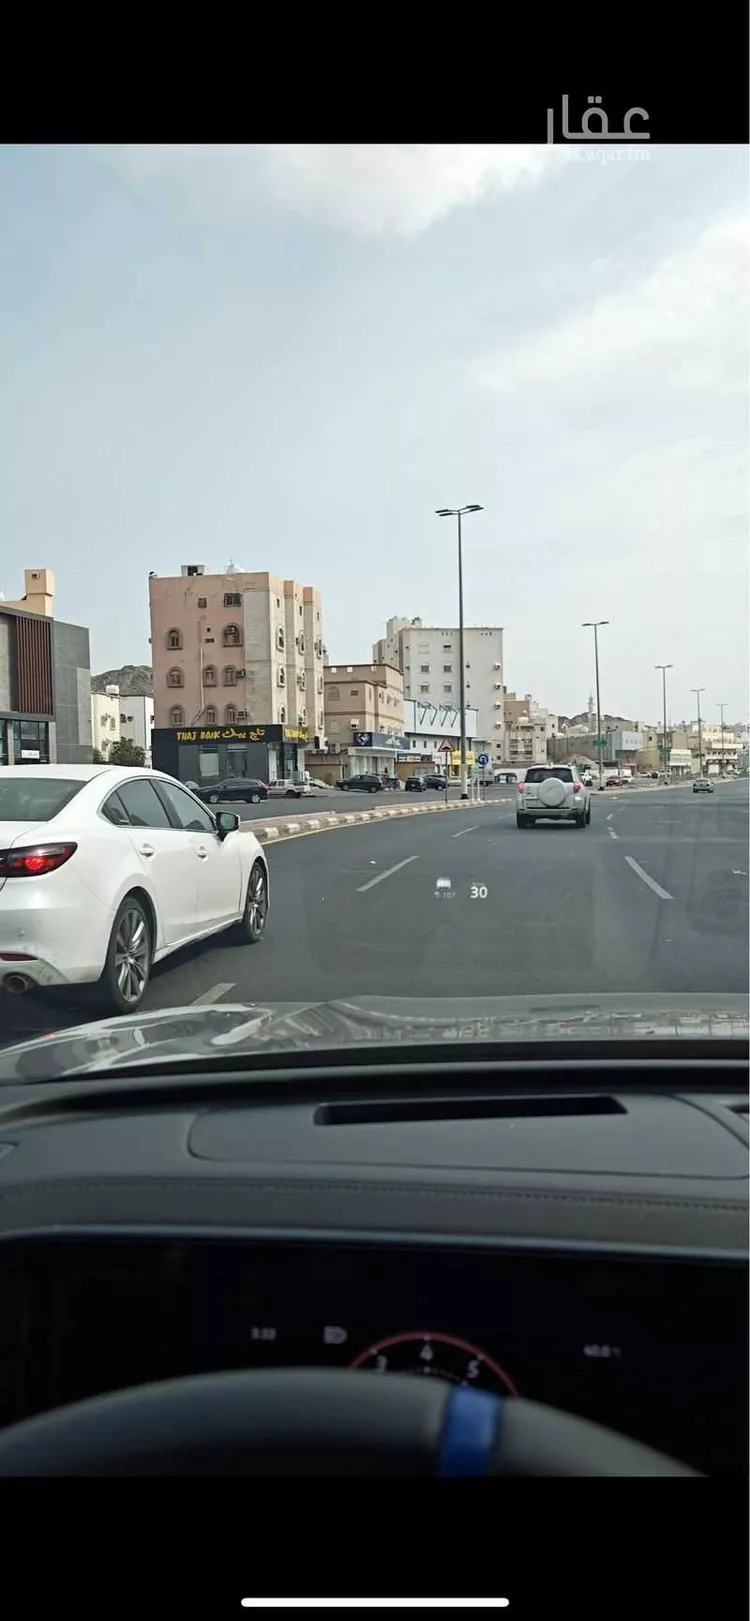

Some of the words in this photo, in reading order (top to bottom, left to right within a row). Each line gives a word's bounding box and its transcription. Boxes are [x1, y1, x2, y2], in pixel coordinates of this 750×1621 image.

[176, 731, 197, 741] THAJ
[200, 730, 221, 740] BAIK
[469, 886, 488, 899] 30
[419, 1344, 434, 1361] 4
[376, 1355, 389, 1373] 3
[466, 1359, 480, 1378] 5
